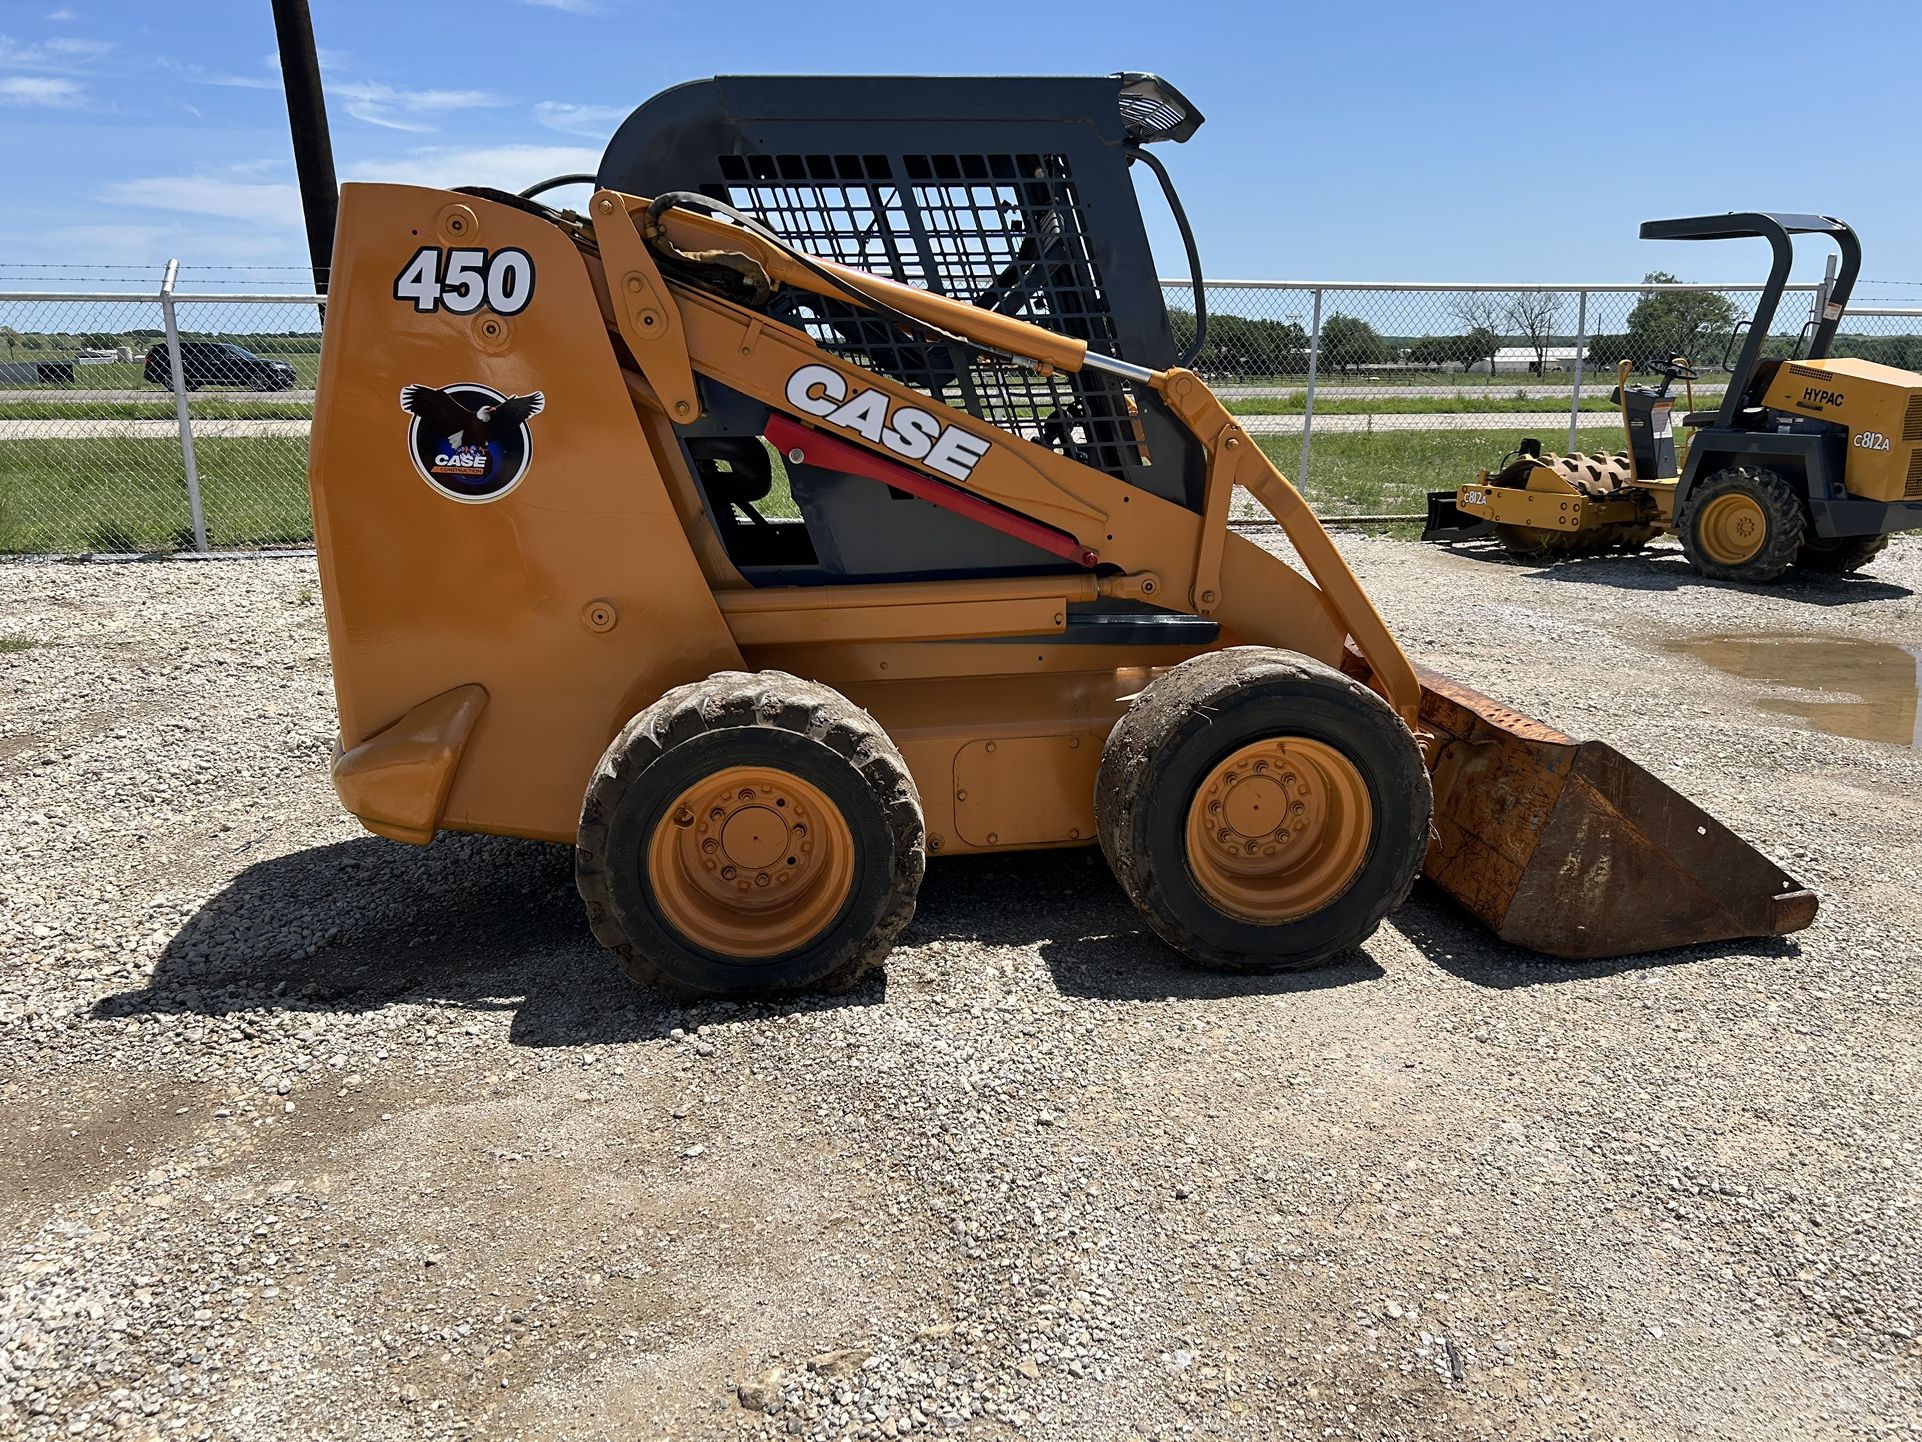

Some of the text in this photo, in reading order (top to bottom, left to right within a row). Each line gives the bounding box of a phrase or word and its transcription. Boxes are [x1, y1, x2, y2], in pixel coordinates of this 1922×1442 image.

[394, 246, 535, 315] 450
[1803, 387, 1844, 407] HYPAC
[785, 364, 992, 481] CASE
[1853, 431, 1891, 451] C812A
[435, 453, 487, 467] CASE
[1463, 491, 1486, 505] C812A
